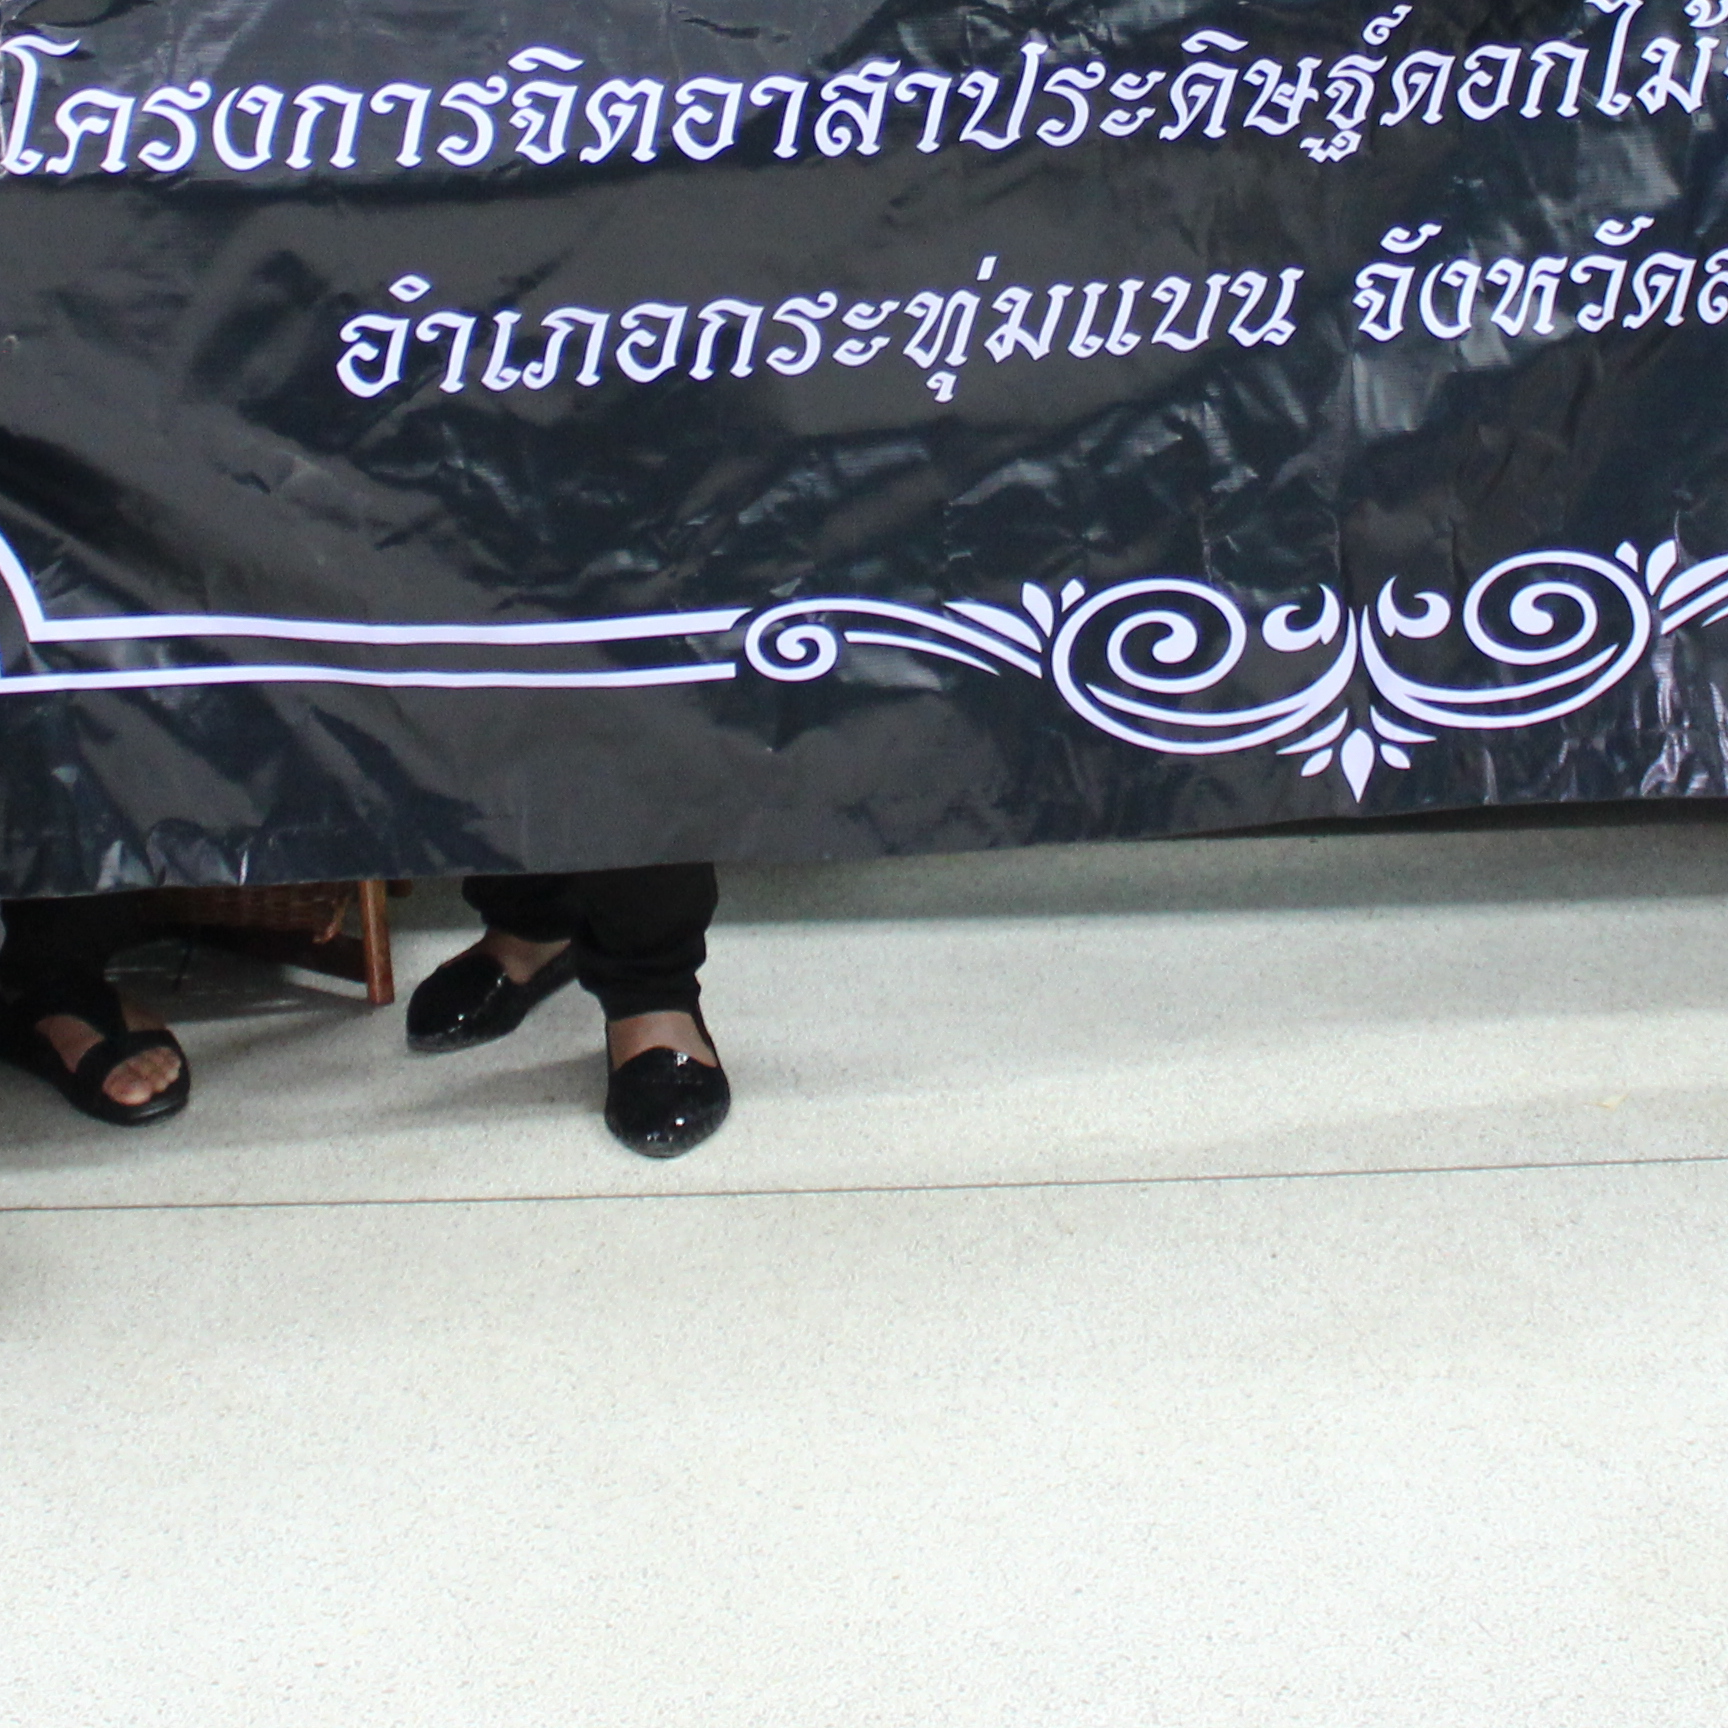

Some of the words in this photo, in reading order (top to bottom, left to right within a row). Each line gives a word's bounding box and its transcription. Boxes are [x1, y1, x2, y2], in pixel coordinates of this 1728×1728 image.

[336, 255, 1304, 402] อำเภอกระทุ่มแบน
